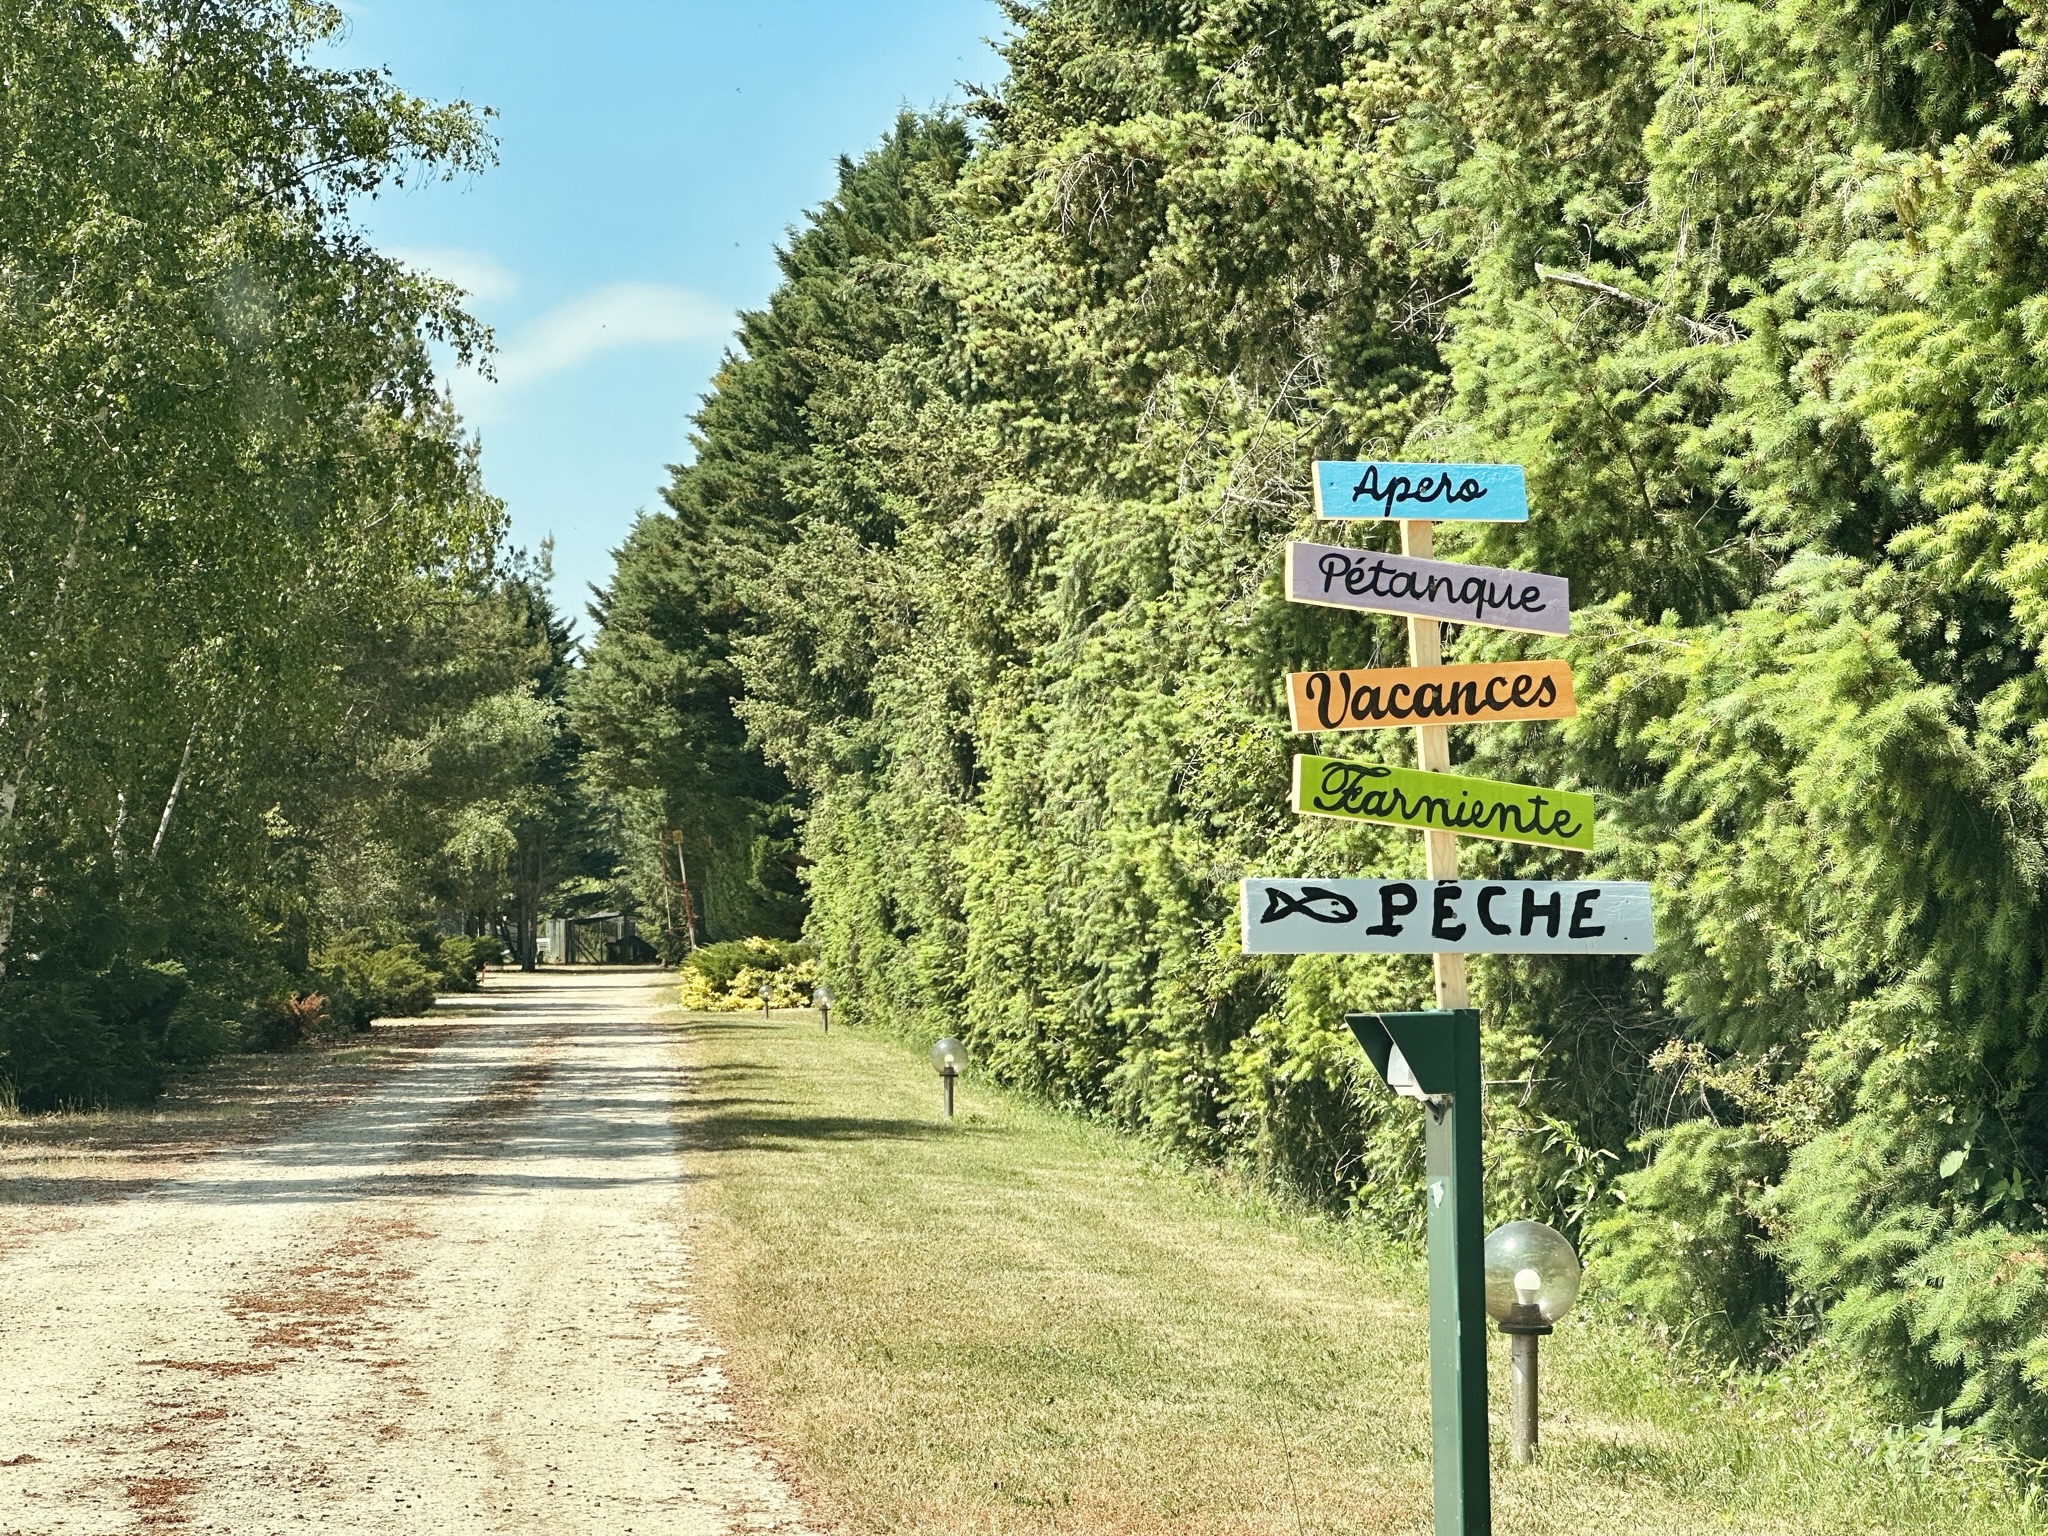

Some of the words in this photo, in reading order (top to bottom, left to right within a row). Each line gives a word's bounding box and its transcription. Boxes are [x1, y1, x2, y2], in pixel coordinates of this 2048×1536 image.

[1352, 464, 1488, 517] Apero
[1318, 552, 1547, 620] Pétanque
[1305, 672, 1558, 730] Vacances
[1313, 762, 1583, 839] Farniente
[1365, 879, 1606, 942] PÊCHE
